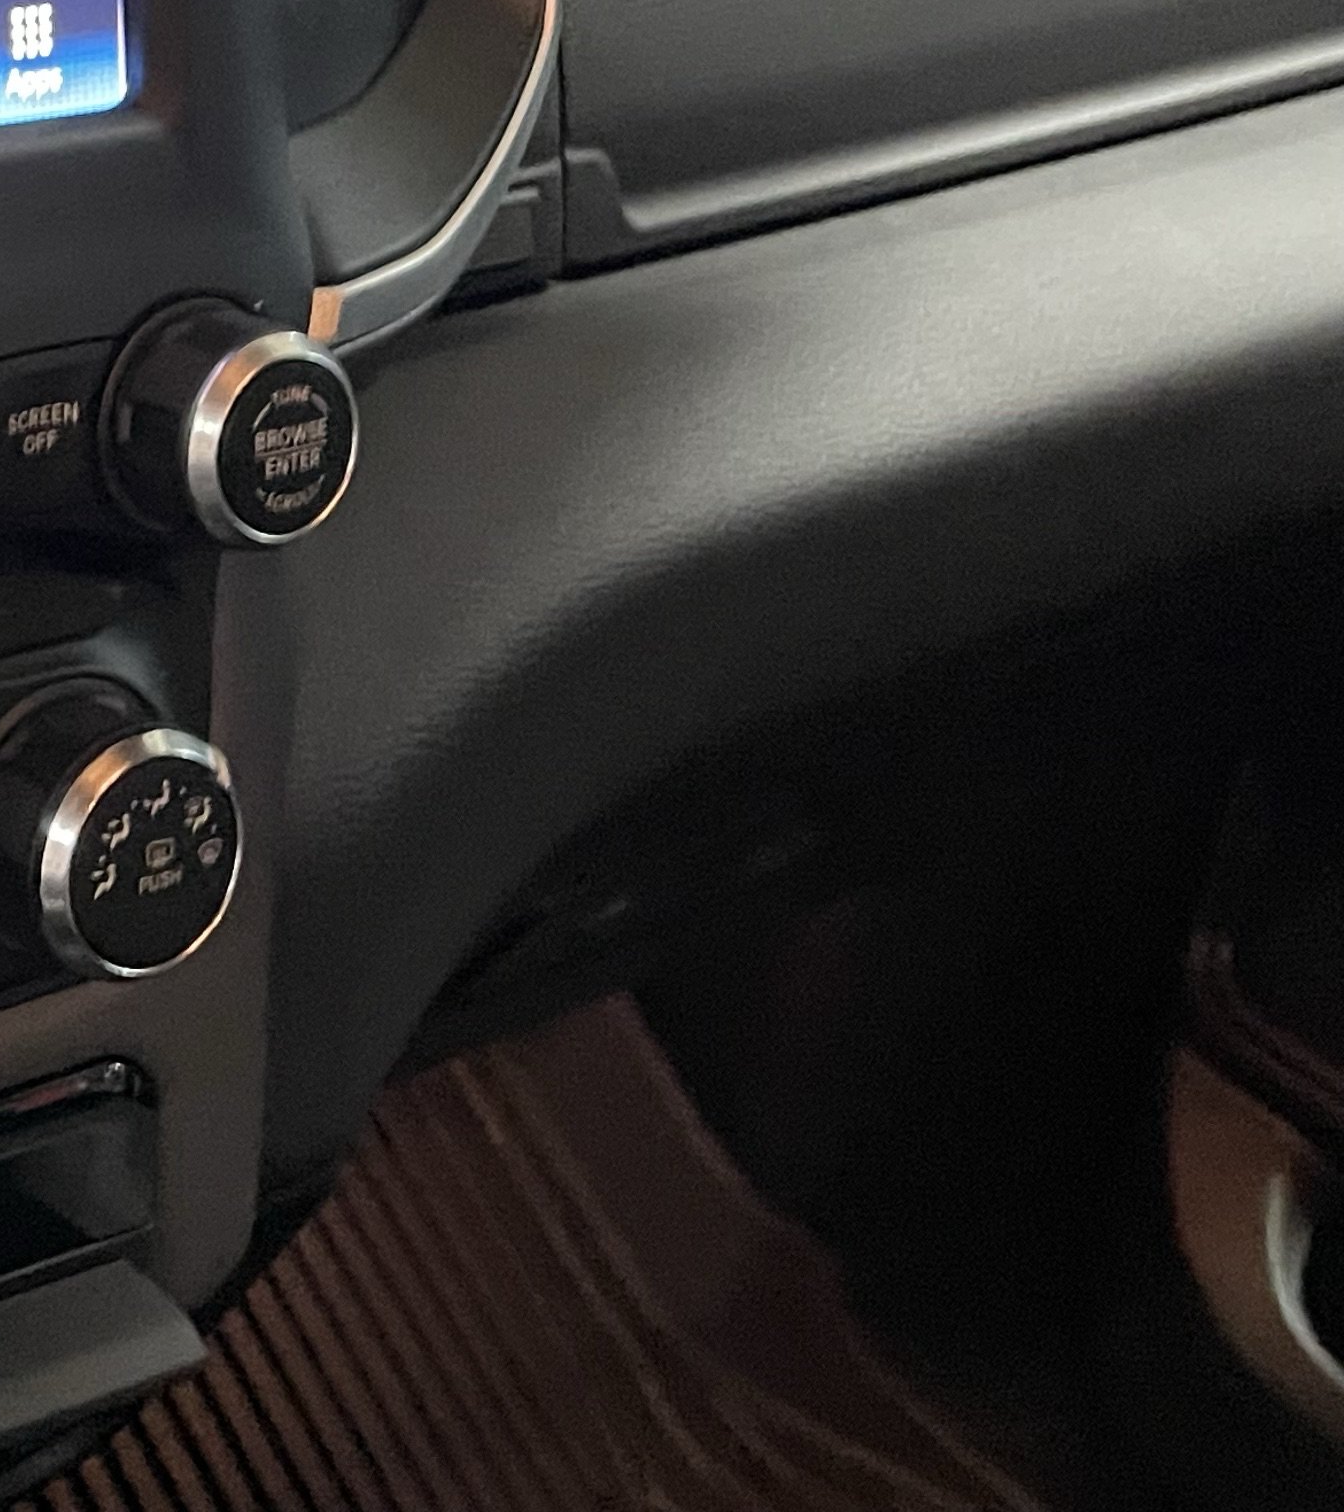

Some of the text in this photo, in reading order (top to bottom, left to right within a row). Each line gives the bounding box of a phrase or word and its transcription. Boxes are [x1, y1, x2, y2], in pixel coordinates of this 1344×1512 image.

[8, 400, 82, 436] SCREEN
[22, 429, 62, 457] OFF
[264, 447, 322, 481] ENTER
